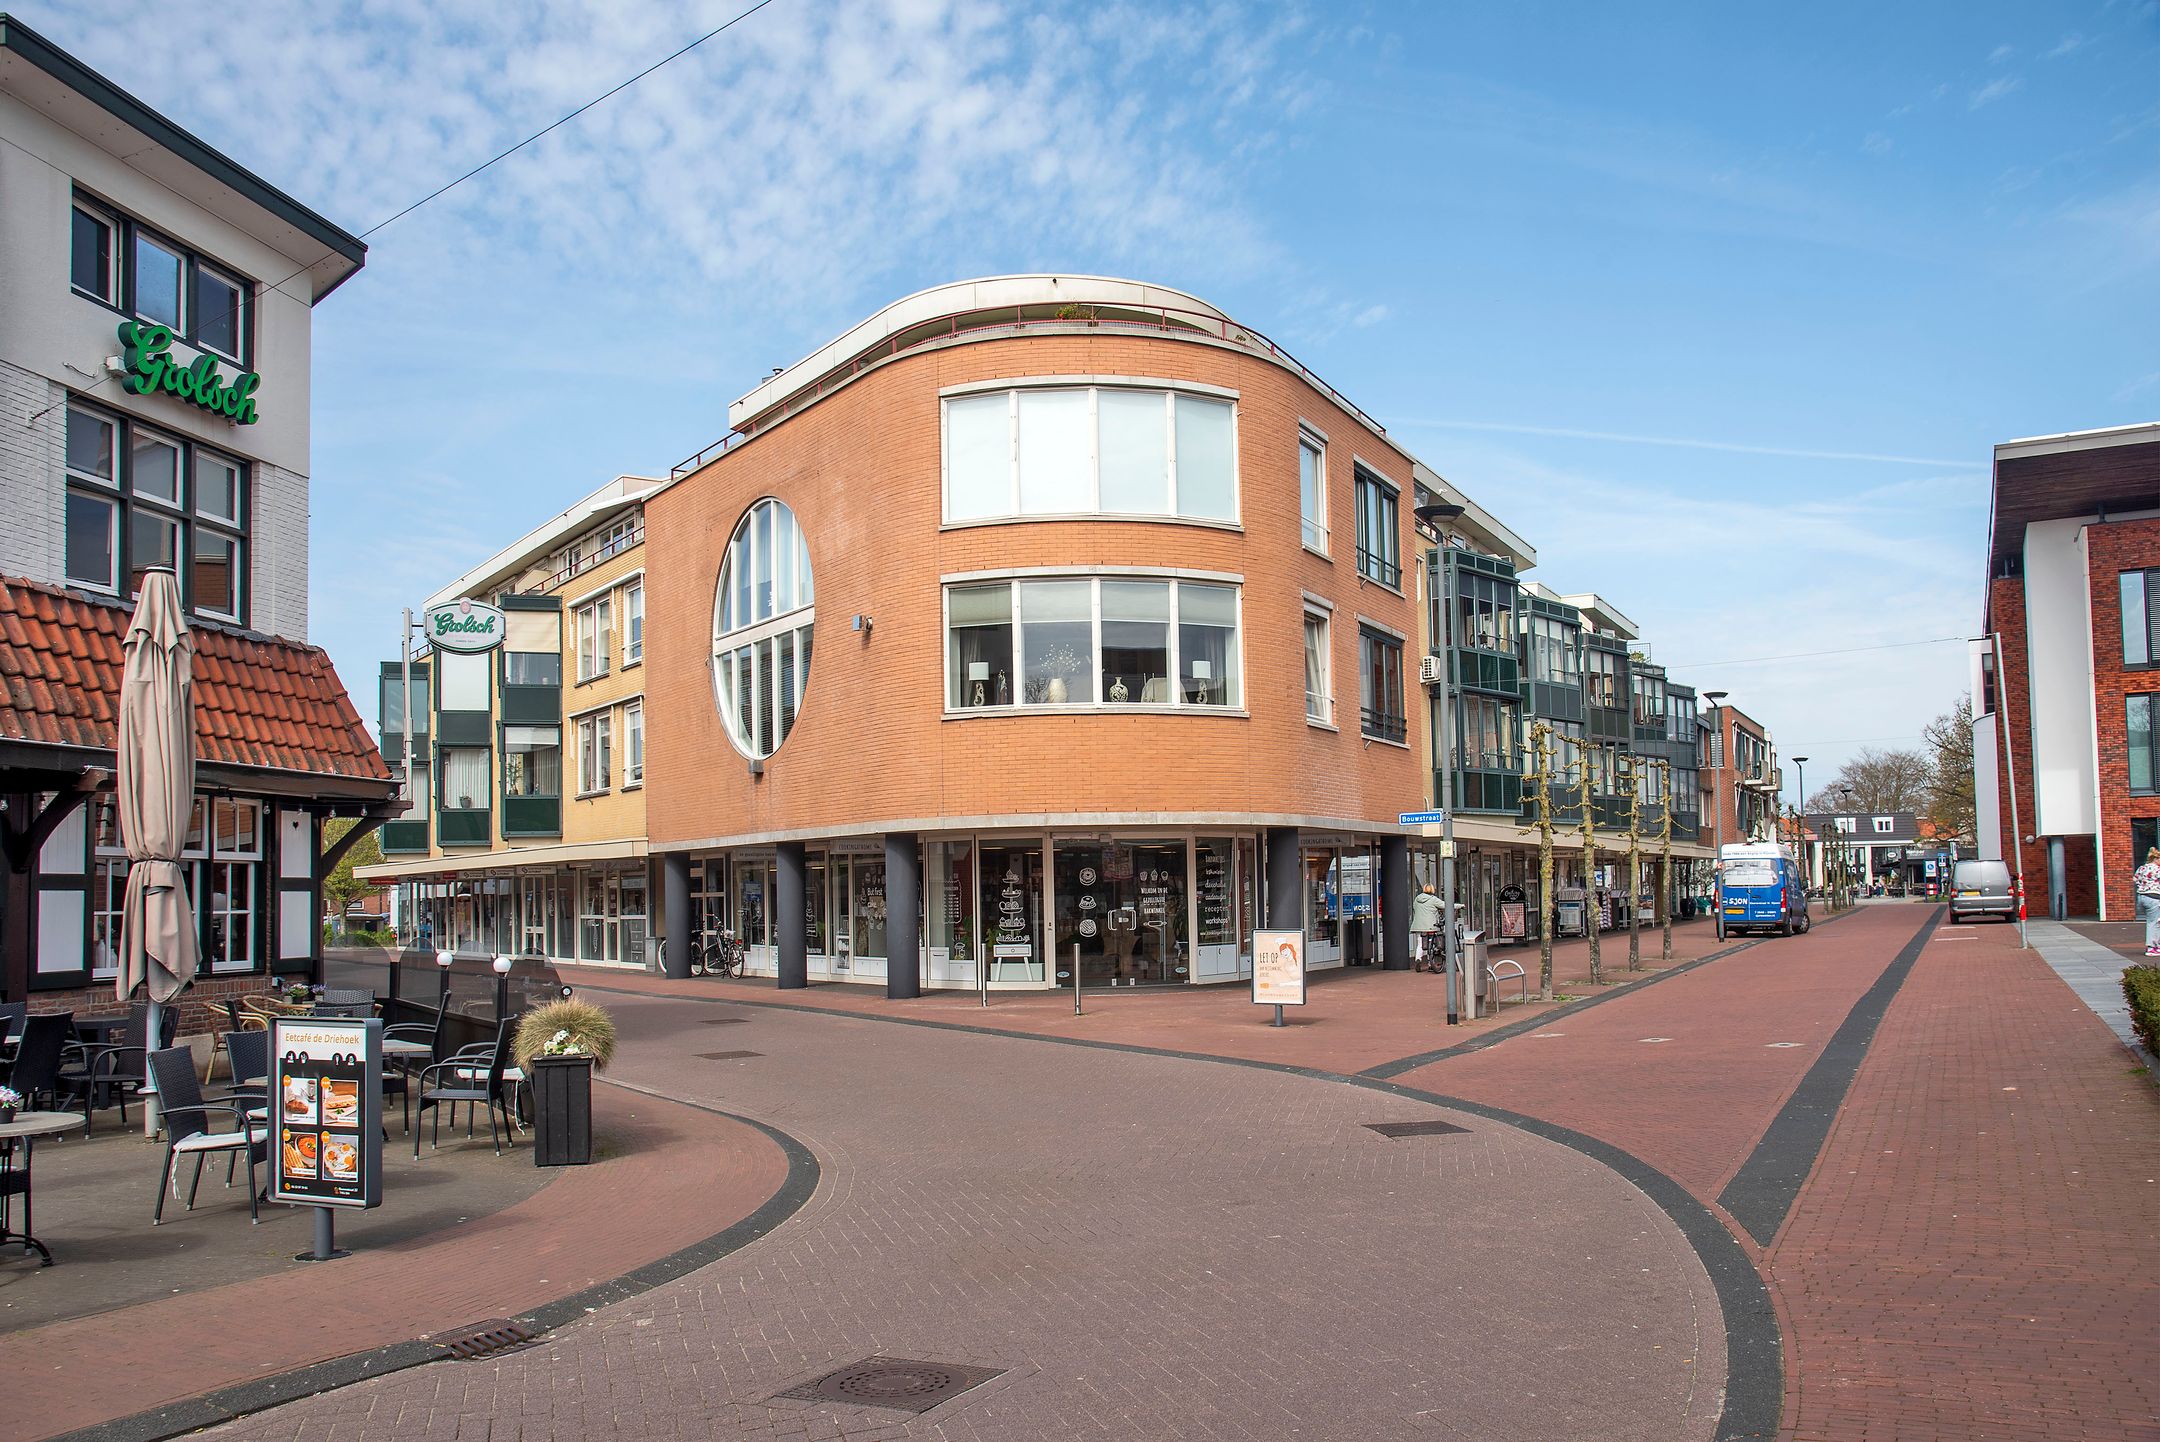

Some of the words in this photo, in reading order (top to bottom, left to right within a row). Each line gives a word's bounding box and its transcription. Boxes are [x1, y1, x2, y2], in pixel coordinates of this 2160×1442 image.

[119, 321, 261, 425] Grolsch
[434, 612, 496, 636] Grolsch
[1402, 815, 1439, 823] Bouwstraat
[1728, 897, 1749, 906] SJON
[1259, 952, 1269, 964] LET
[1270, 952, 1279, 964] OP
[285, 1032, 312, 1043] Eetcafé
[313, 1033, 323, 1043] de
[324, 1034, 360, 1044] Driehoek
